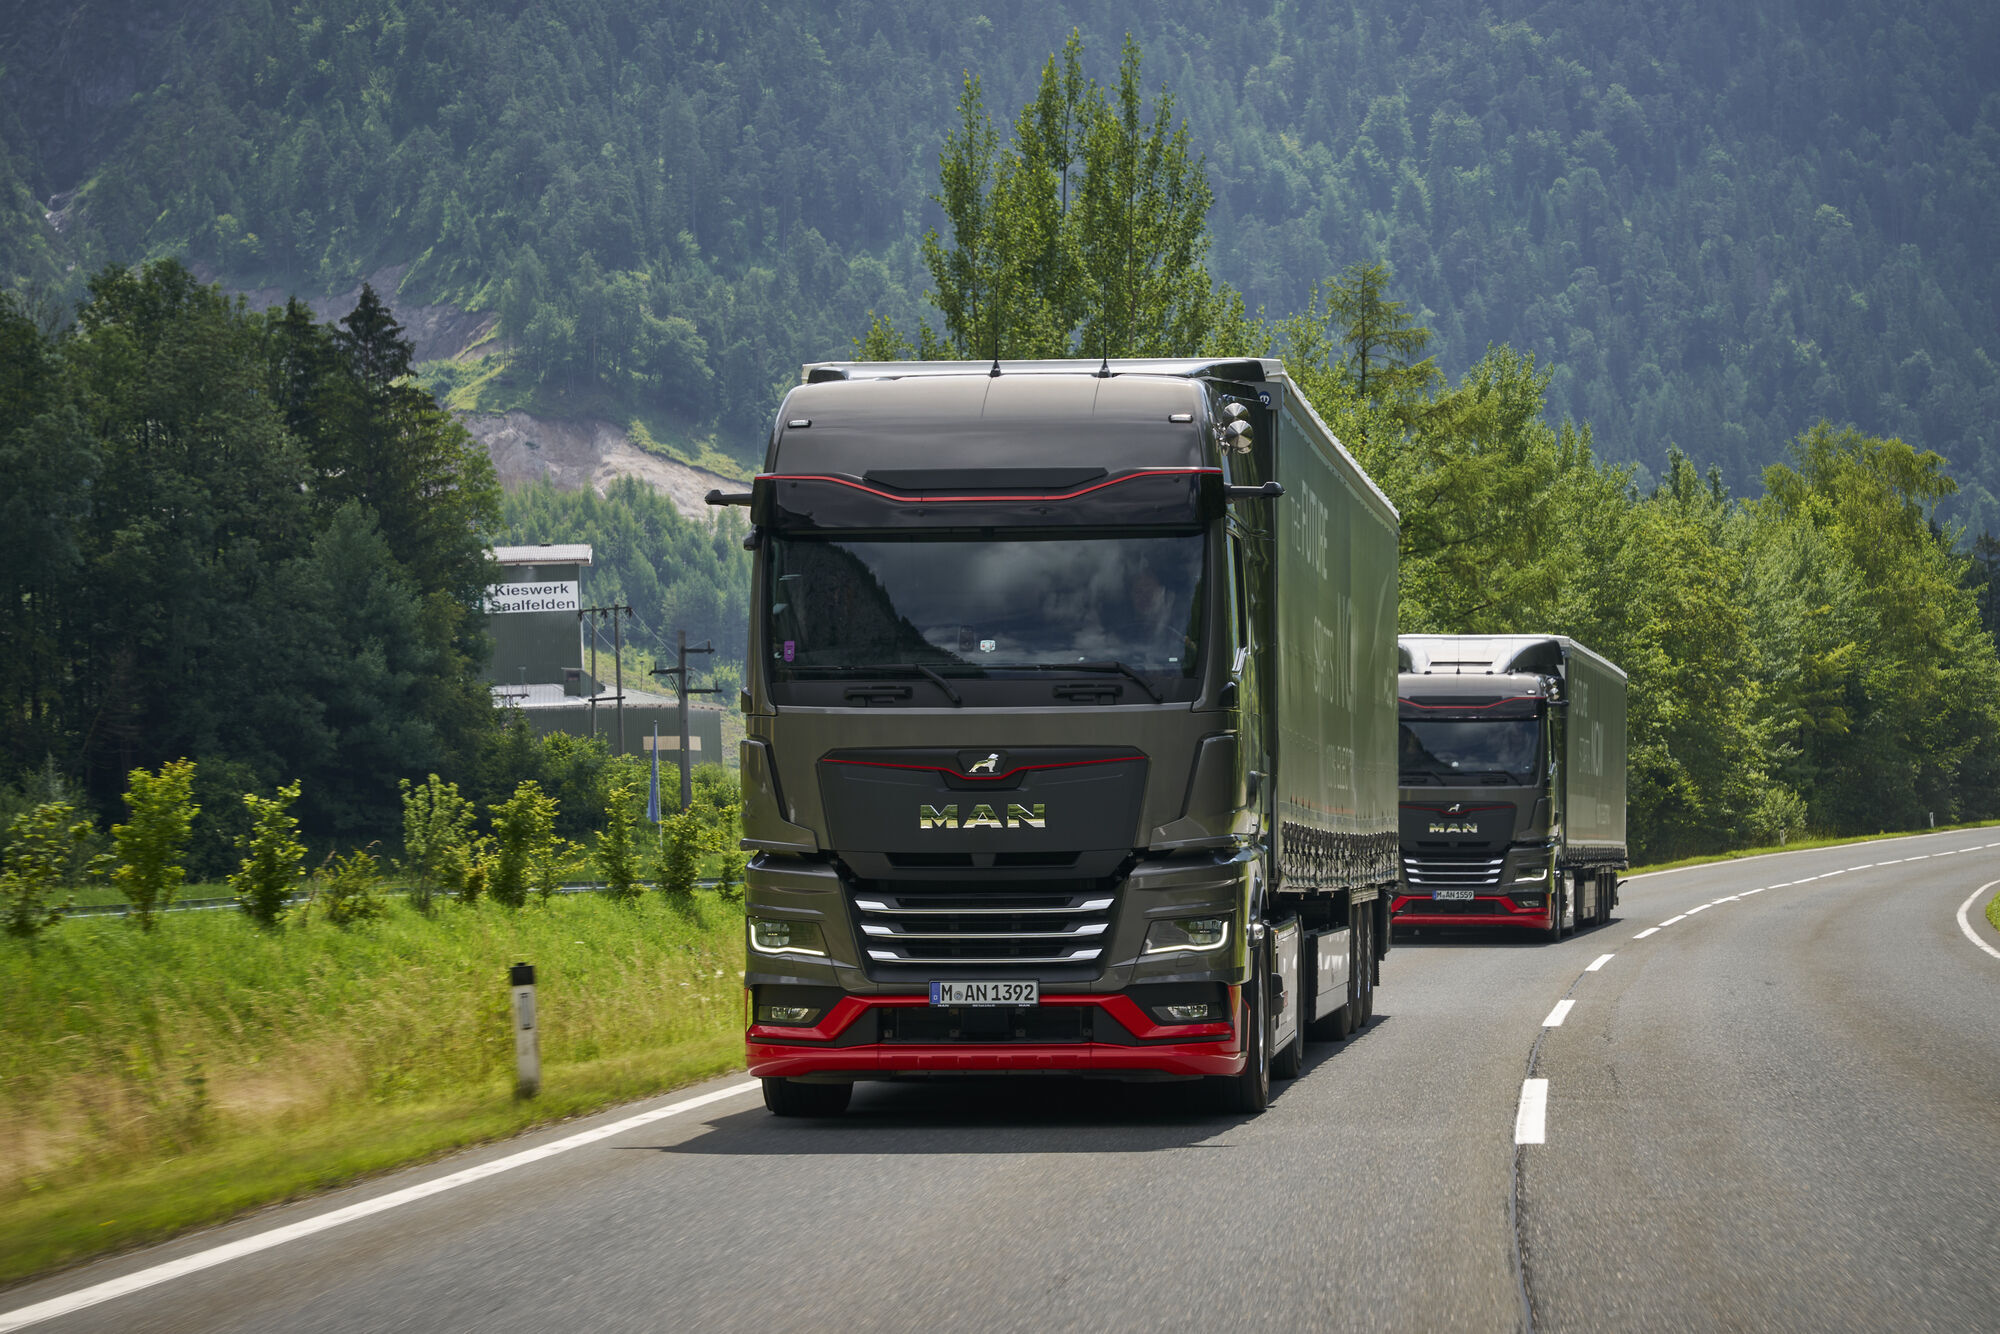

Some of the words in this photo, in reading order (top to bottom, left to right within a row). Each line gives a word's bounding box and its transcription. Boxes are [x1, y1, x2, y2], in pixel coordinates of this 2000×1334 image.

[495, 583, 569, 596] Kieswerk
[491, 599, 576, 612] Saalfelden
[920, 803, 1046, 829] MAN
[1429, 822, 1478, 833] MAN
[941, 984, 953, 1001] M
[965, 984, 987, 1001] AN
[991, 984, 1034, 1001] 1392
